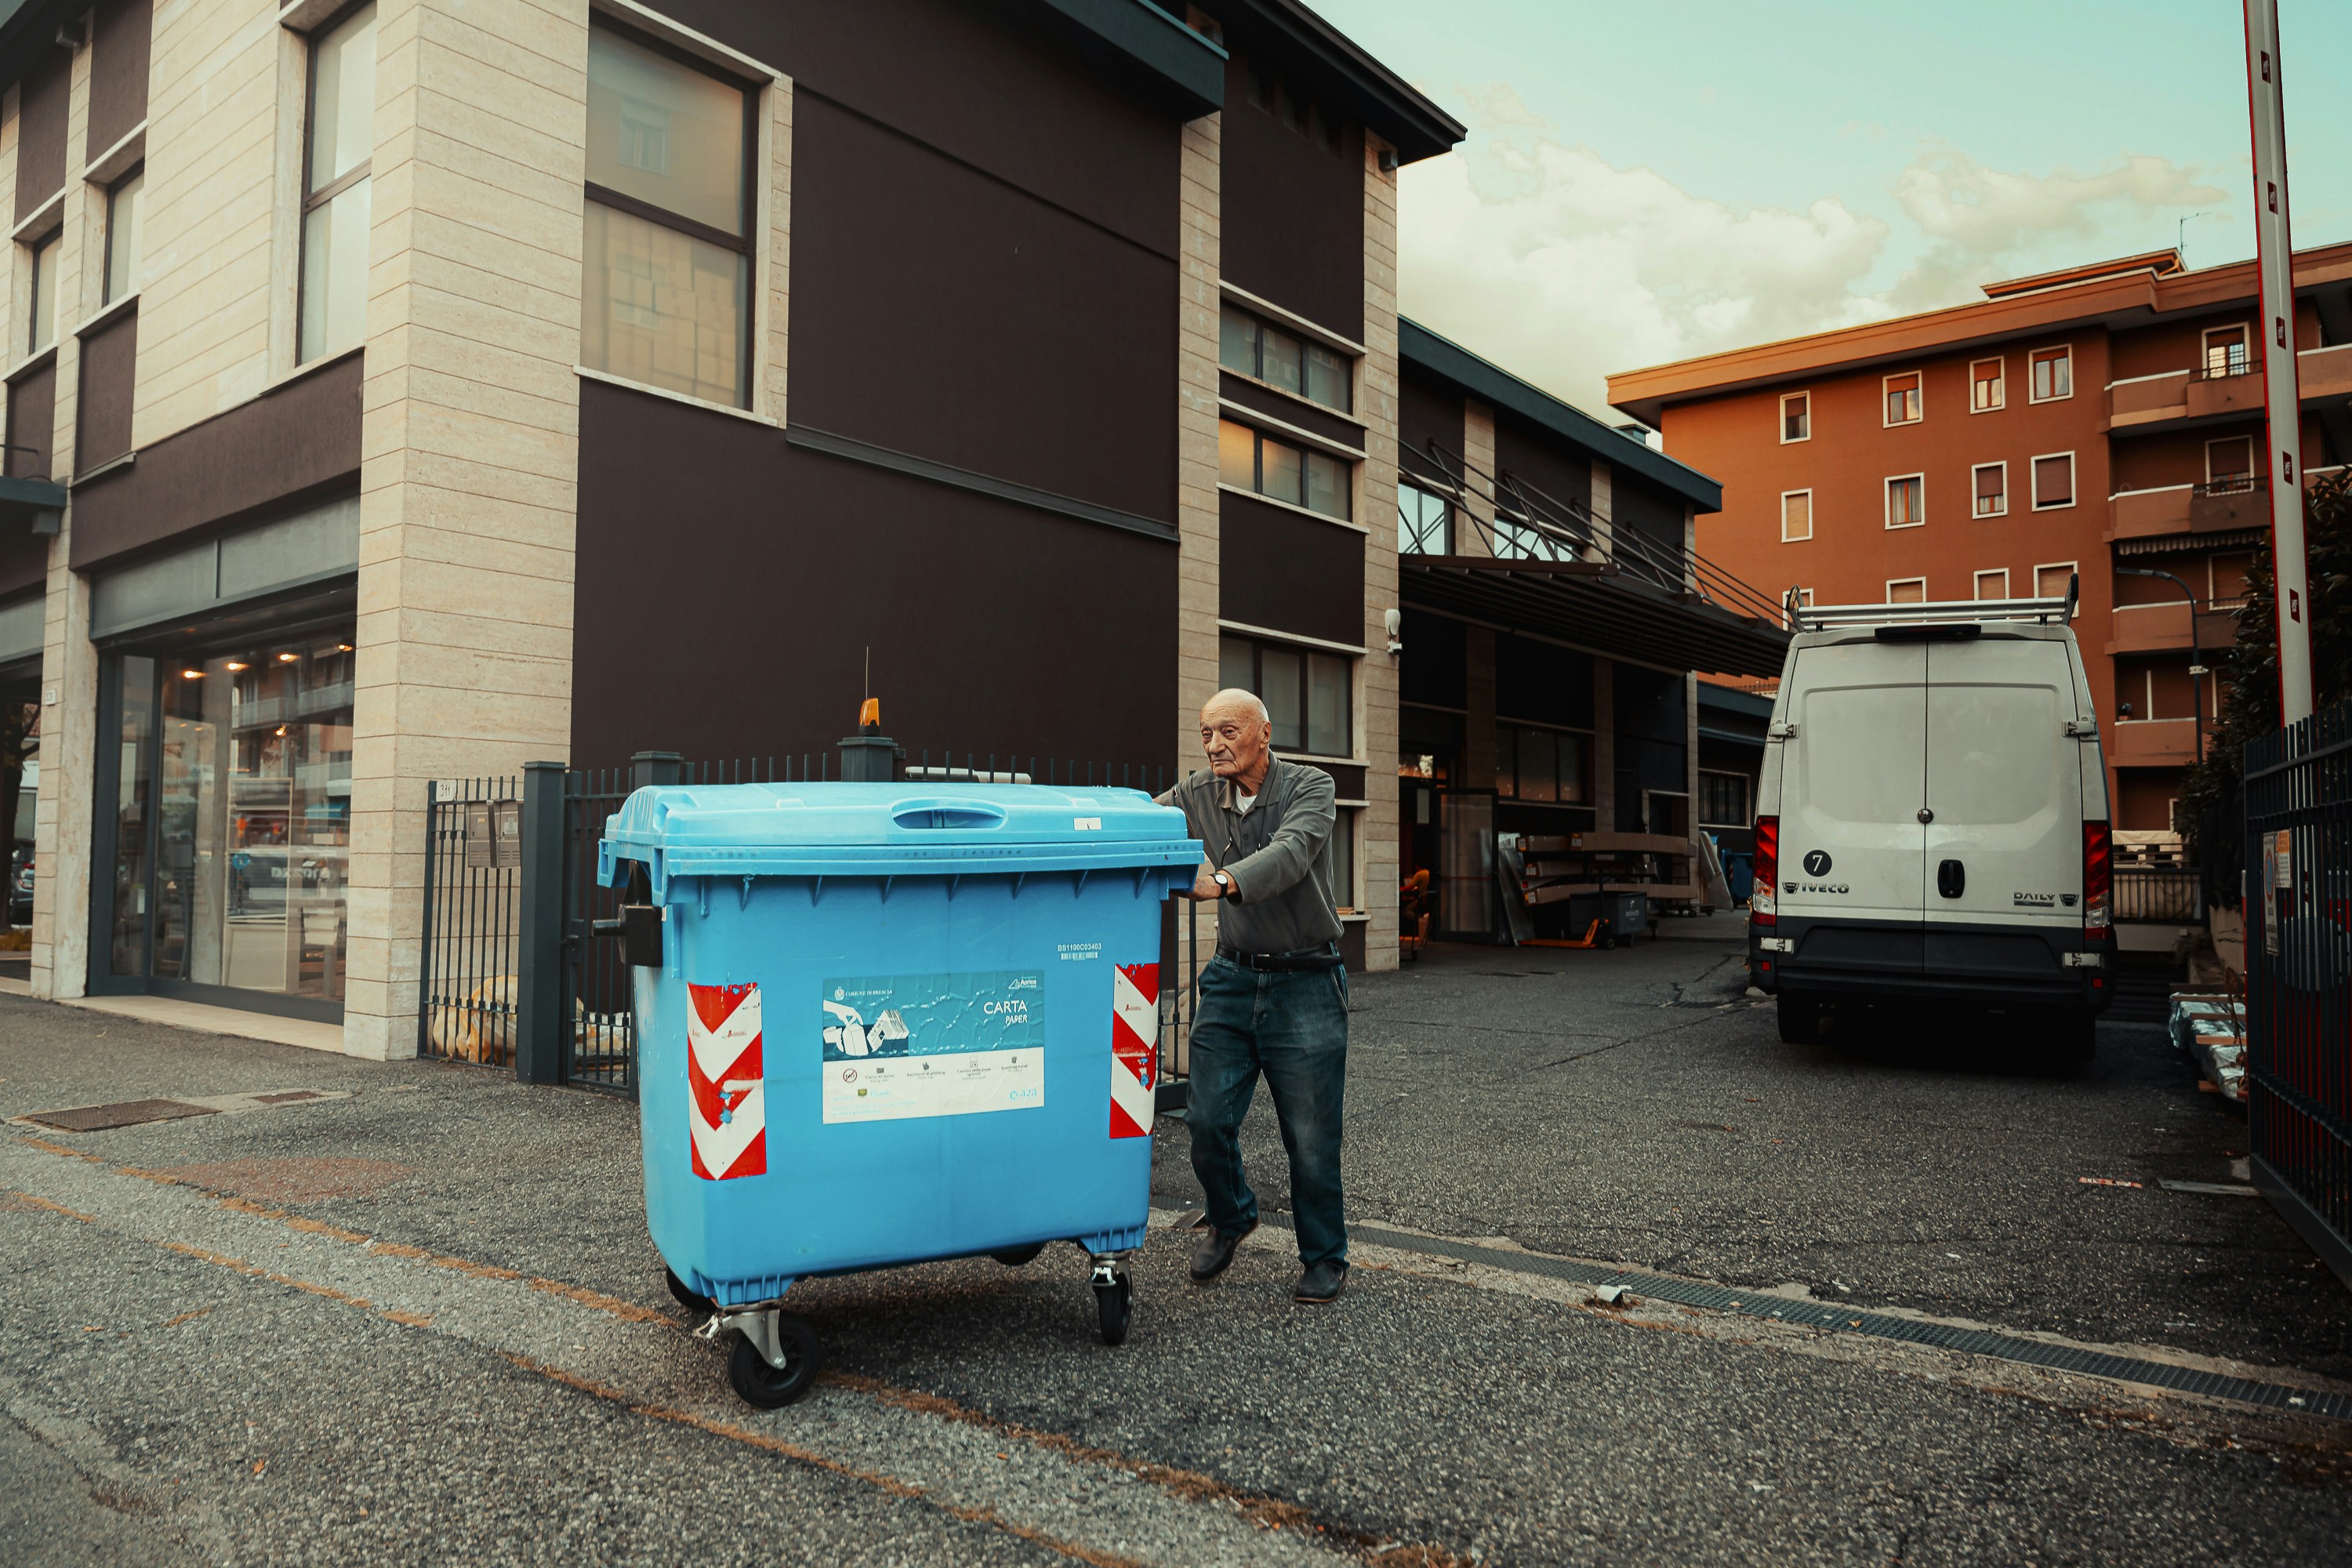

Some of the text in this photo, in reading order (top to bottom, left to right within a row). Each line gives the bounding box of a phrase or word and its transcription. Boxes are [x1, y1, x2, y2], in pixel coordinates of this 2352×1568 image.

[440, 784, 451, 797] 311
[1812, 855, 1823, 872] 7
[1802, 882, 1849, 894] IVECO
[2013, 891, 2056, 901] DAILY
[983, 1000, 1028, 1014] CARTA
[1005, 1014, 1028, 1024] PAPER
